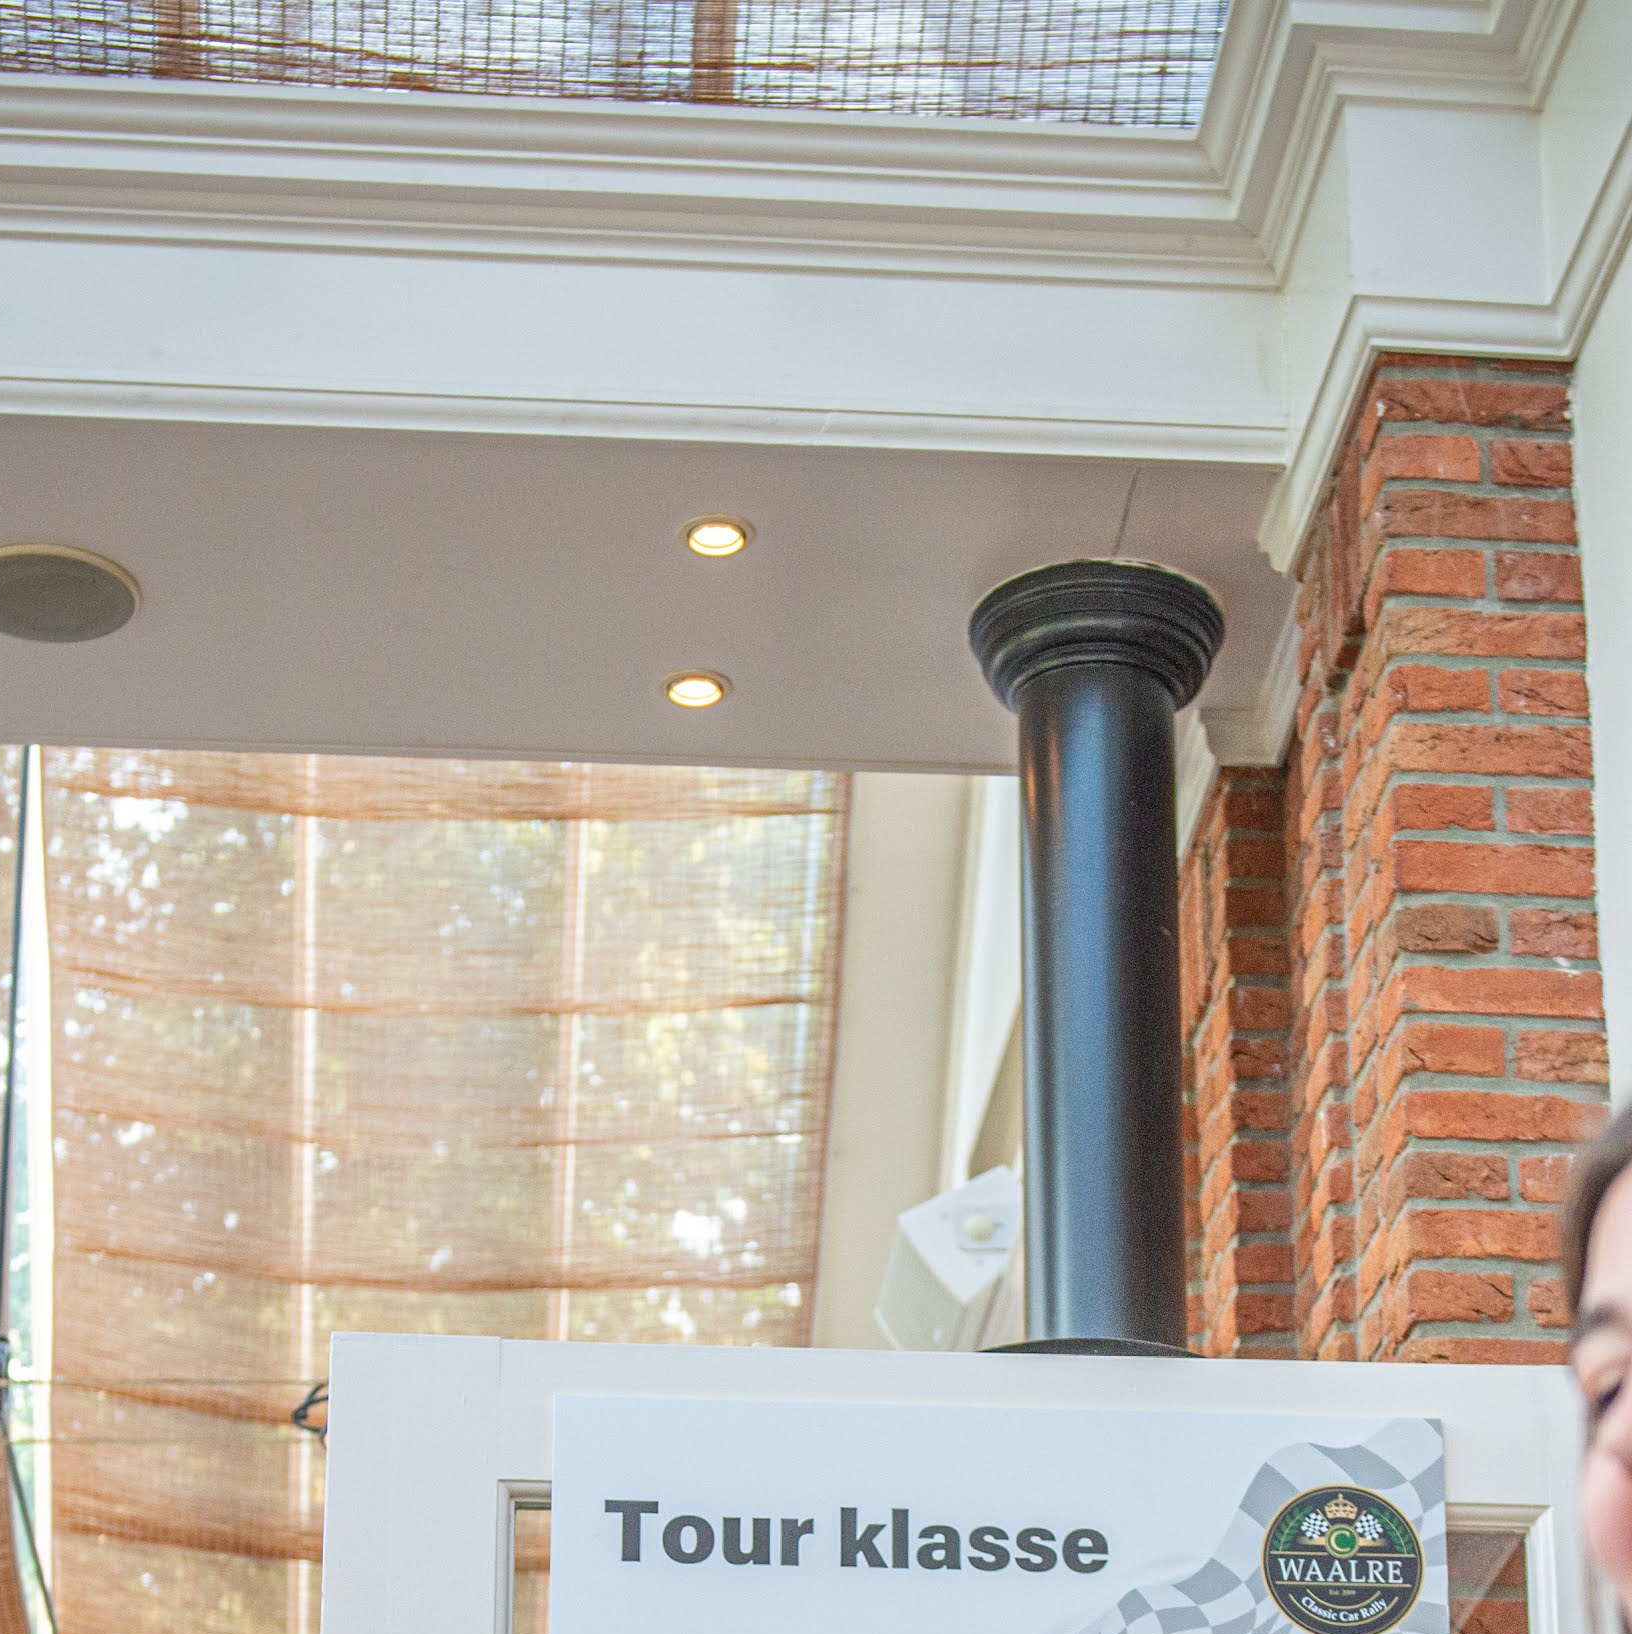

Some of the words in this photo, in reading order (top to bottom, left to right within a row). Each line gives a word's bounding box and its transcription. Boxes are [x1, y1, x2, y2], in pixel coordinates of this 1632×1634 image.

[604, 1499, 815, 1567] Tour
[839, 1506, 1110, 1575] klasse
[1329, 1529, 1351, 1552] C
[1277, 1557, 1404, 1584] WAALRE
[1301, 1596, 1338, 1622] Classic
[1339, 1610, 1360, 1623] Car
[1360, 1597, 1388, 1619] Rally
